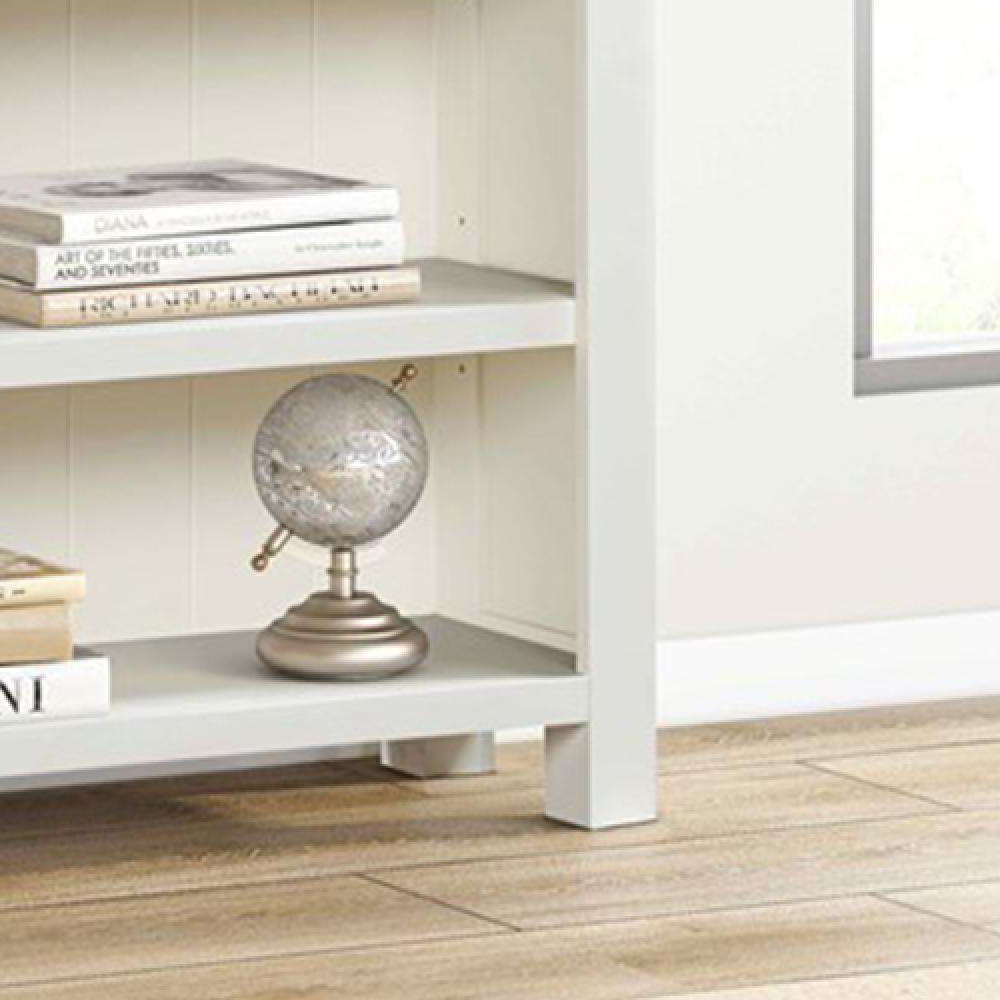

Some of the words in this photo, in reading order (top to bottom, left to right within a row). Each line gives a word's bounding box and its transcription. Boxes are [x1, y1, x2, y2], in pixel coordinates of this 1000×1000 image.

[94, 214, 149, 233] DIANA
[55, 248, 80, 265] ART
[85, 247, 105, 263] OF
[109, 246, 131, 262] THE
[55, 264, 88, 280] AND
[91, 261, 160, 279] SEVENTIES
